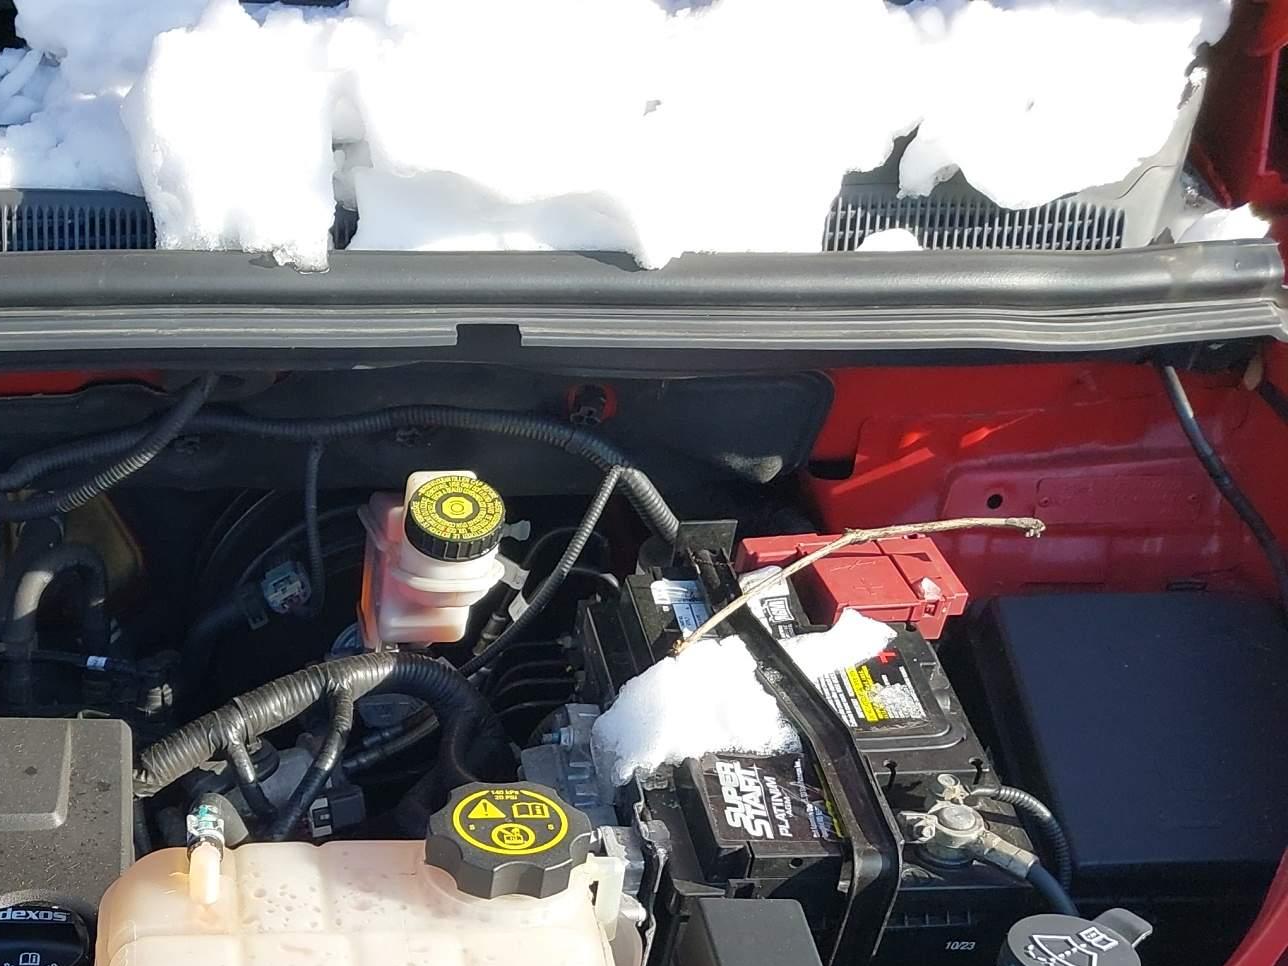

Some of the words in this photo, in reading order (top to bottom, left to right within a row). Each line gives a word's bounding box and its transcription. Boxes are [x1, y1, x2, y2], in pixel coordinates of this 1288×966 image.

[715, 761, 743, 828] SUPER
[735, 761, 775, 840] START
[763, 776, 793, 838] PLATINUM
[944, 940, 976, 951] 10/23
